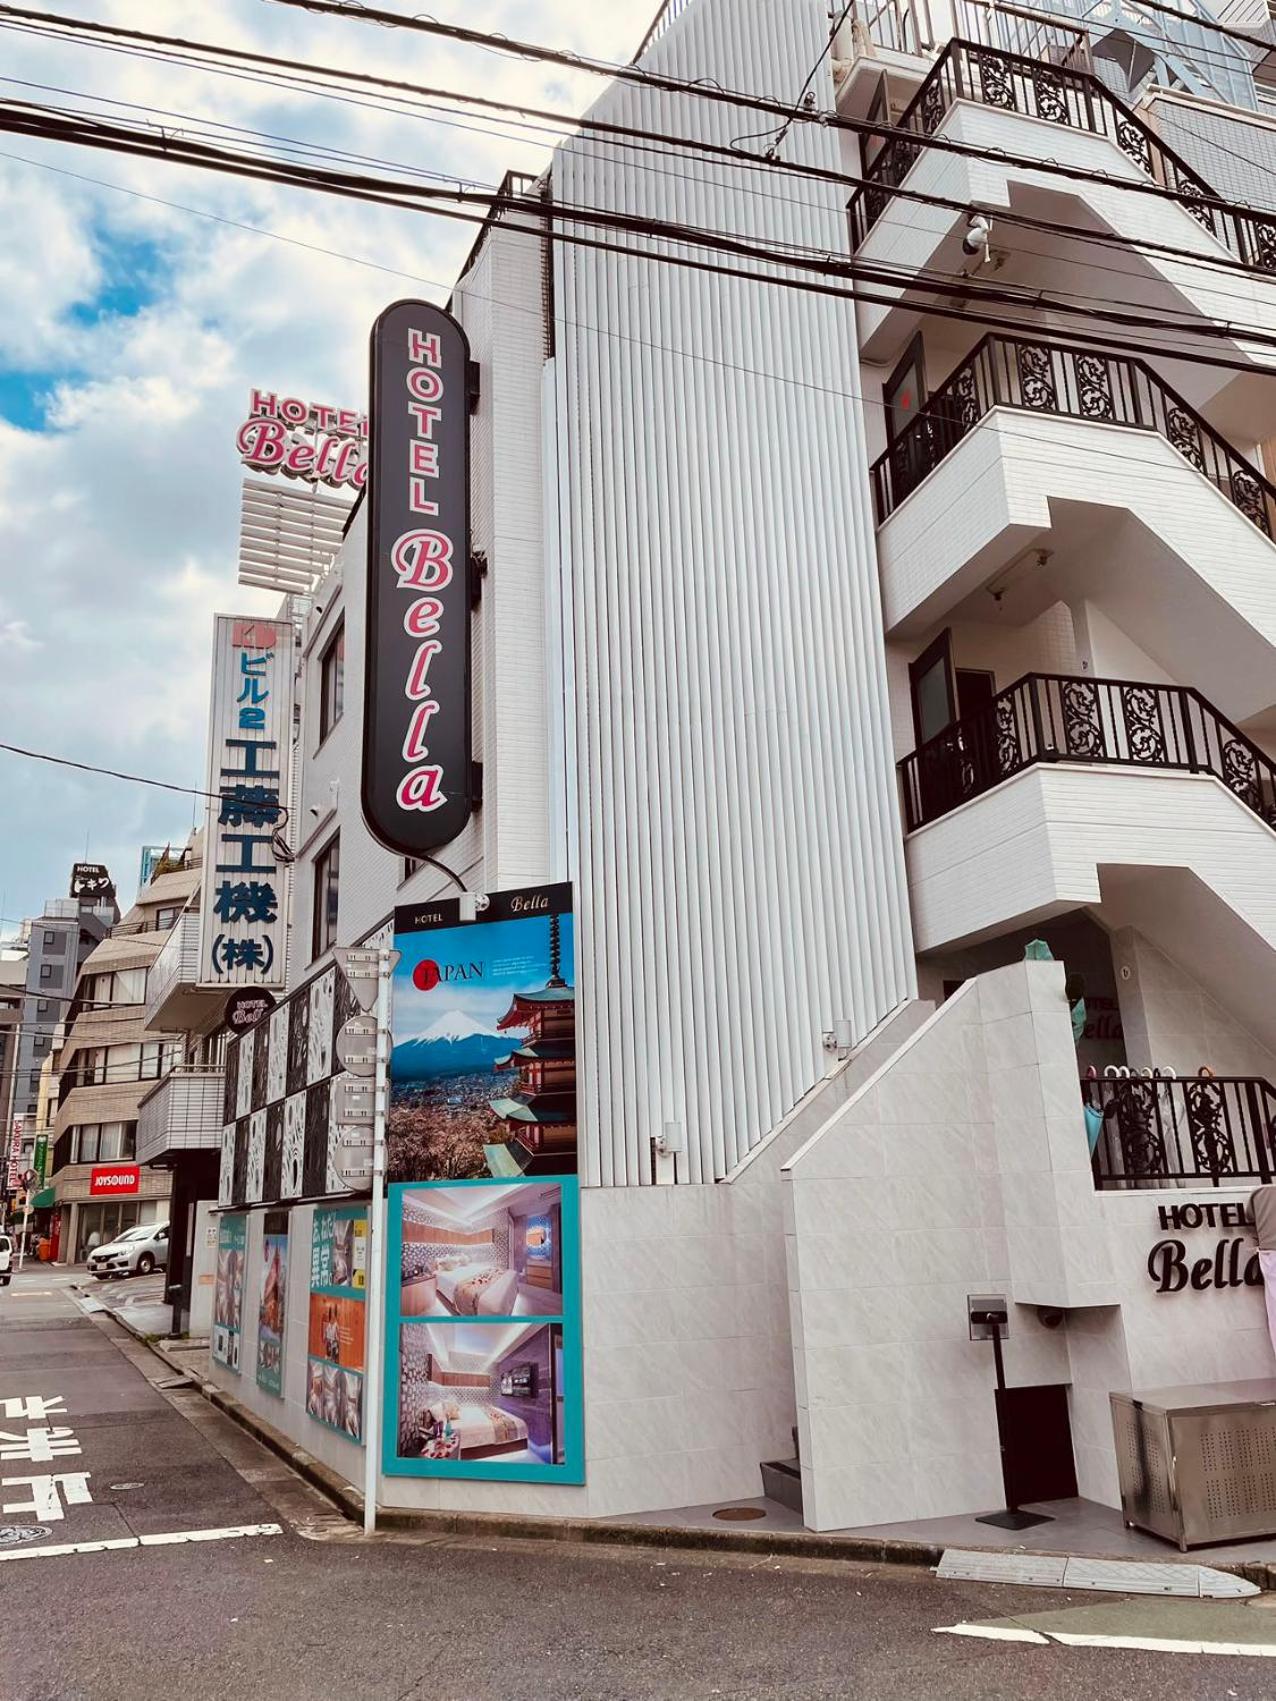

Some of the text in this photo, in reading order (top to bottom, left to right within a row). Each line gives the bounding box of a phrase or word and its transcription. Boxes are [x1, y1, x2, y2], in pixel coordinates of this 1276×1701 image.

[407, 327, 443, 517] HOTEL
[390, 528, 455, 813] Bella
[414, 894, 549, 925] HOTEL Bella
[419, 960, 484, 986] JAPAN
[95, 1174, 135, 1186] JOYSOUND
